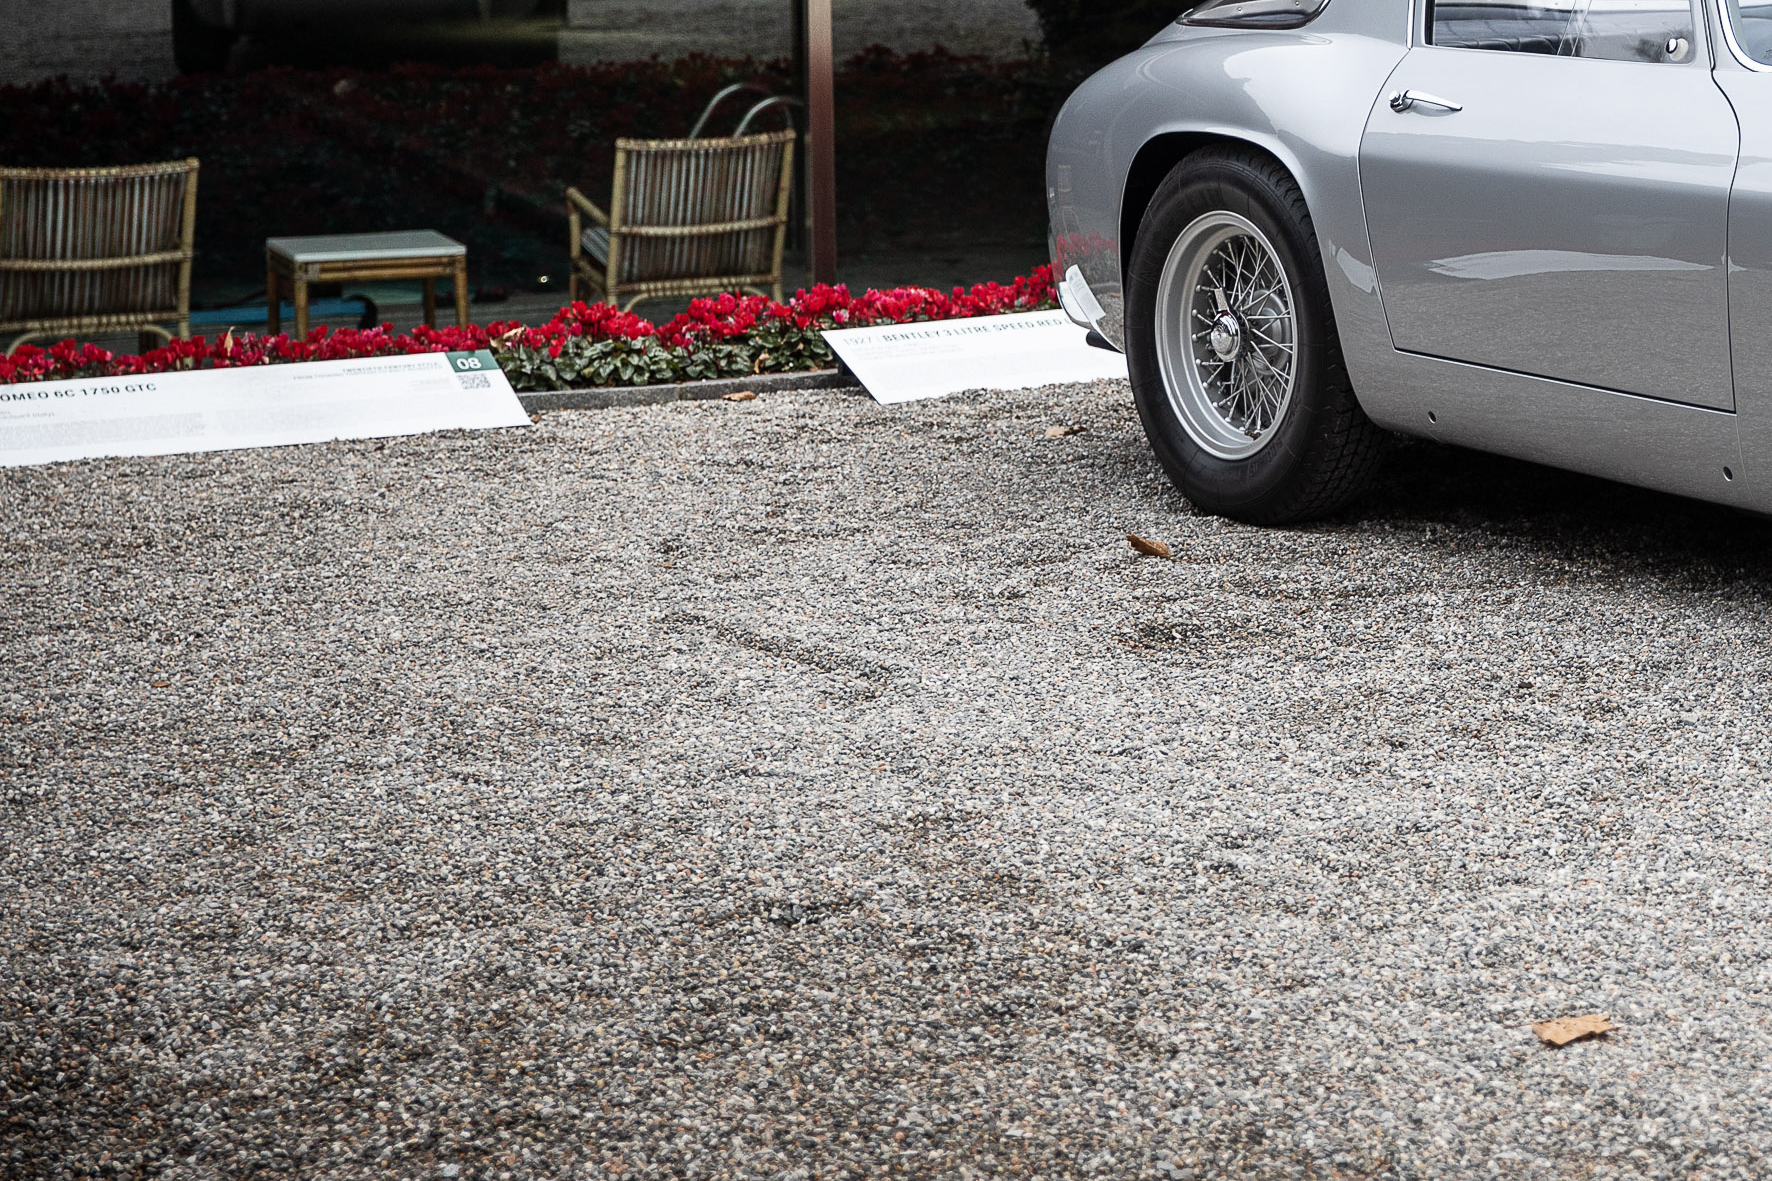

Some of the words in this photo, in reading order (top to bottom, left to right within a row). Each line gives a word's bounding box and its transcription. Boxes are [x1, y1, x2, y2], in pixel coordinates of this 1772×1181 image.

[882, 330, 940, 342] BENTLEY
[954, 326, 990, 336] LITRE
[992, 321, 1034, 332] SPEED
[1036, 318, 1063, 328] RED
[455, 356, 483, 370] 08
[53, 389, 76, 399] 6C
[81, 386, 121, 396] 1750
[125, 383, 157, 394] GTC
